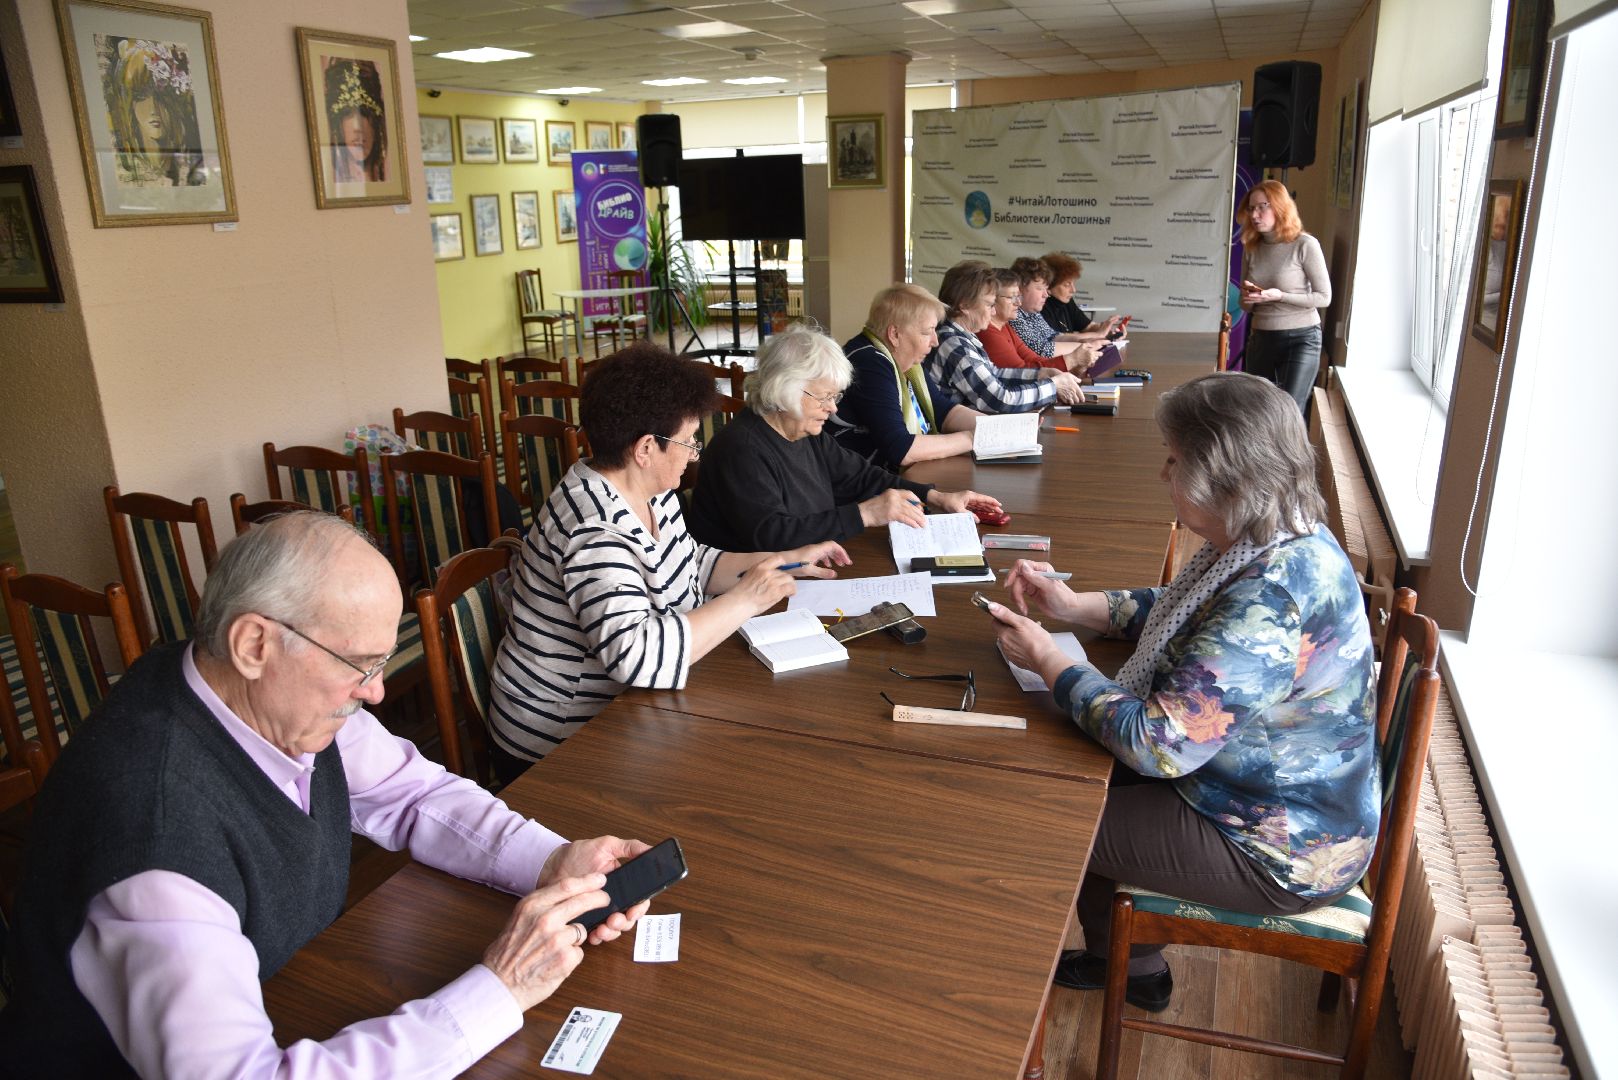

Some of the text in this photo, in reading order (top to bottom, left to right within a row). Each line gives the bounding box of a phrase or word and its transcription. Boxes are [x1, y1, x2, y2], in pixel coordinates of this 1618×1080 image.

[1008, 195, 1097, 207] #ЧитайЛотошино
[598, 206, 635, 220] ДРАЙВ
[994, 212, 1111, 225] Библиотеки Лотошинья
